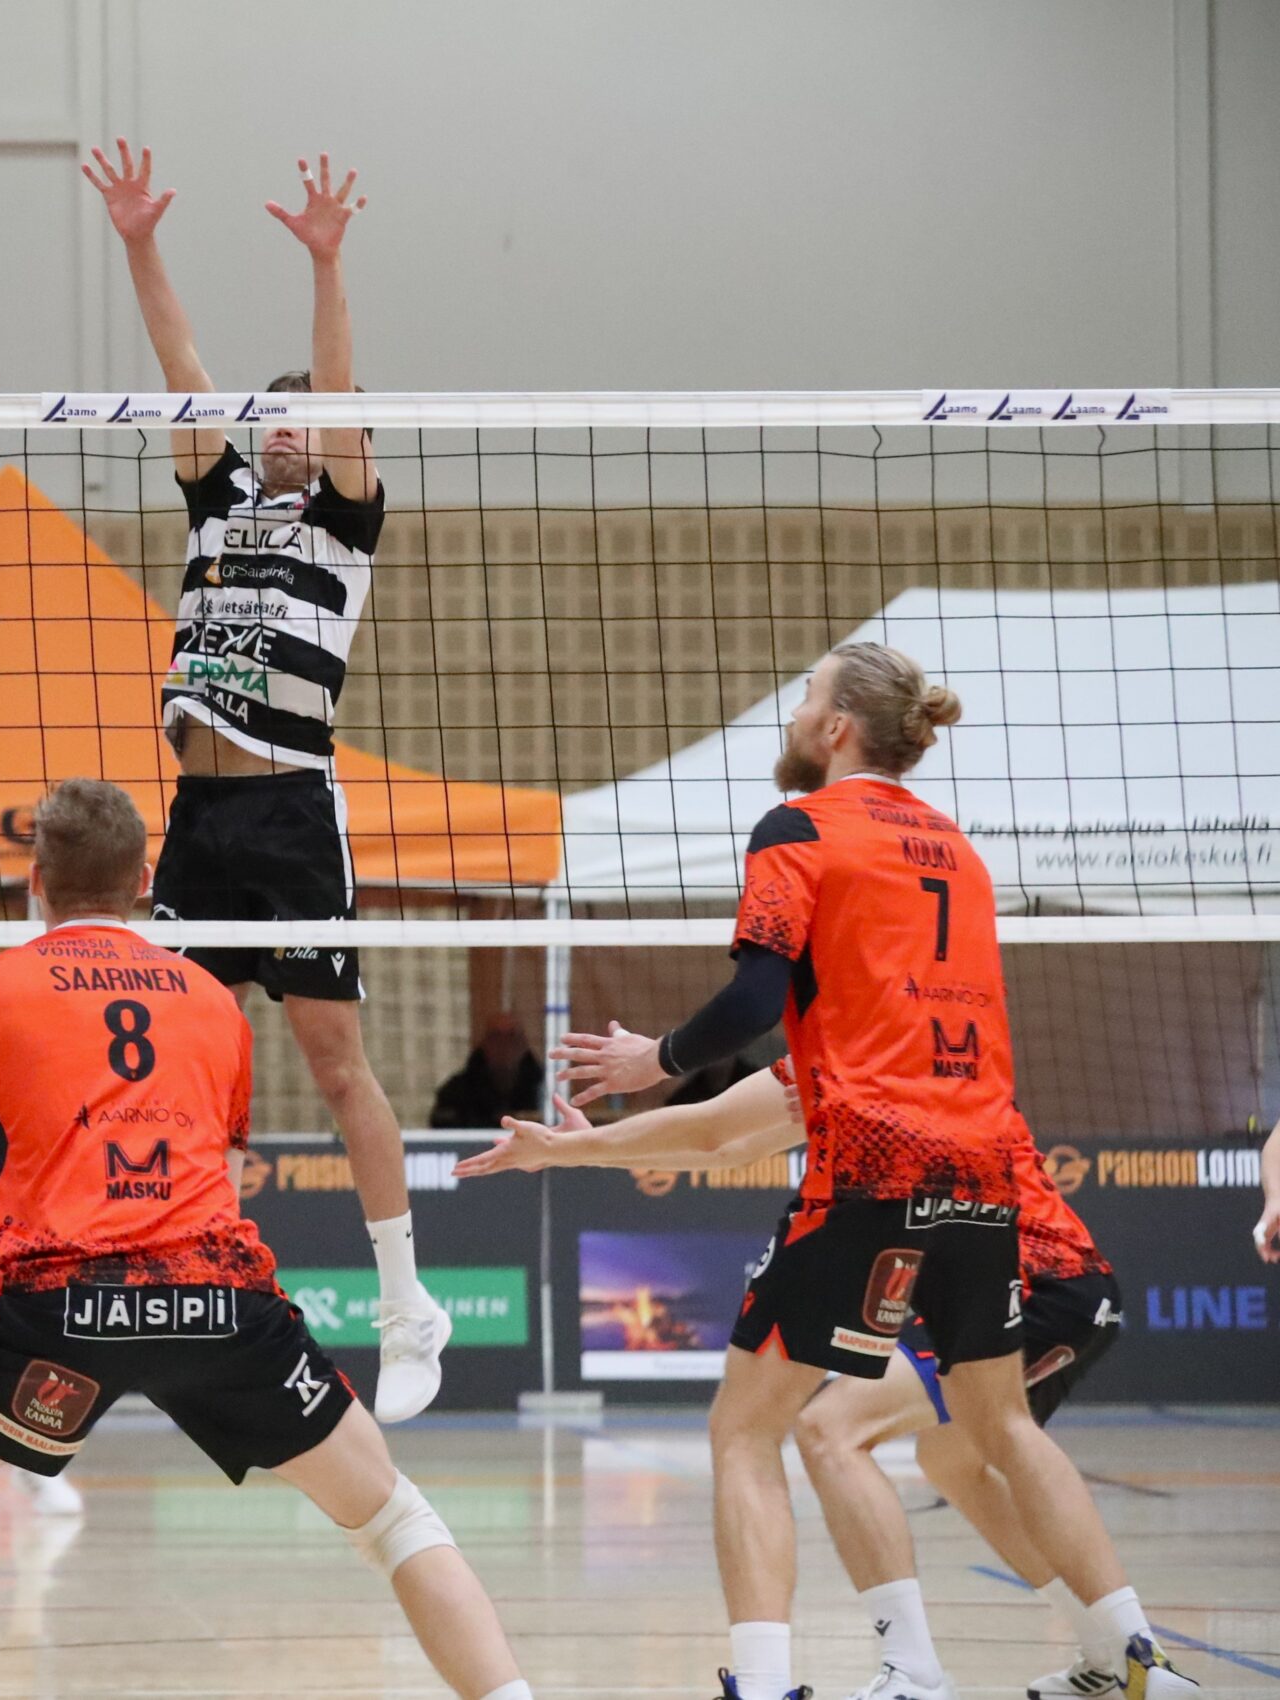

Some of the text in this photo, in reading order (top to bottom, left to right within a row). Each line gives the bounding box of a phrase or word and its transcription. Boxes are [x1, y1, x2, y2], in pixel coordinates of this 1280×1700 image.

[920, 877, 950, 961] 7
[49, 965, 188, 994] SAARINEN
[103, 1000, 155, 1082] 8
[98, 1107, 170, 1124] AARNIO
[106, 1180, 172, 1200] MASKU
[1145, 1285, 1268, 1329] LINE
